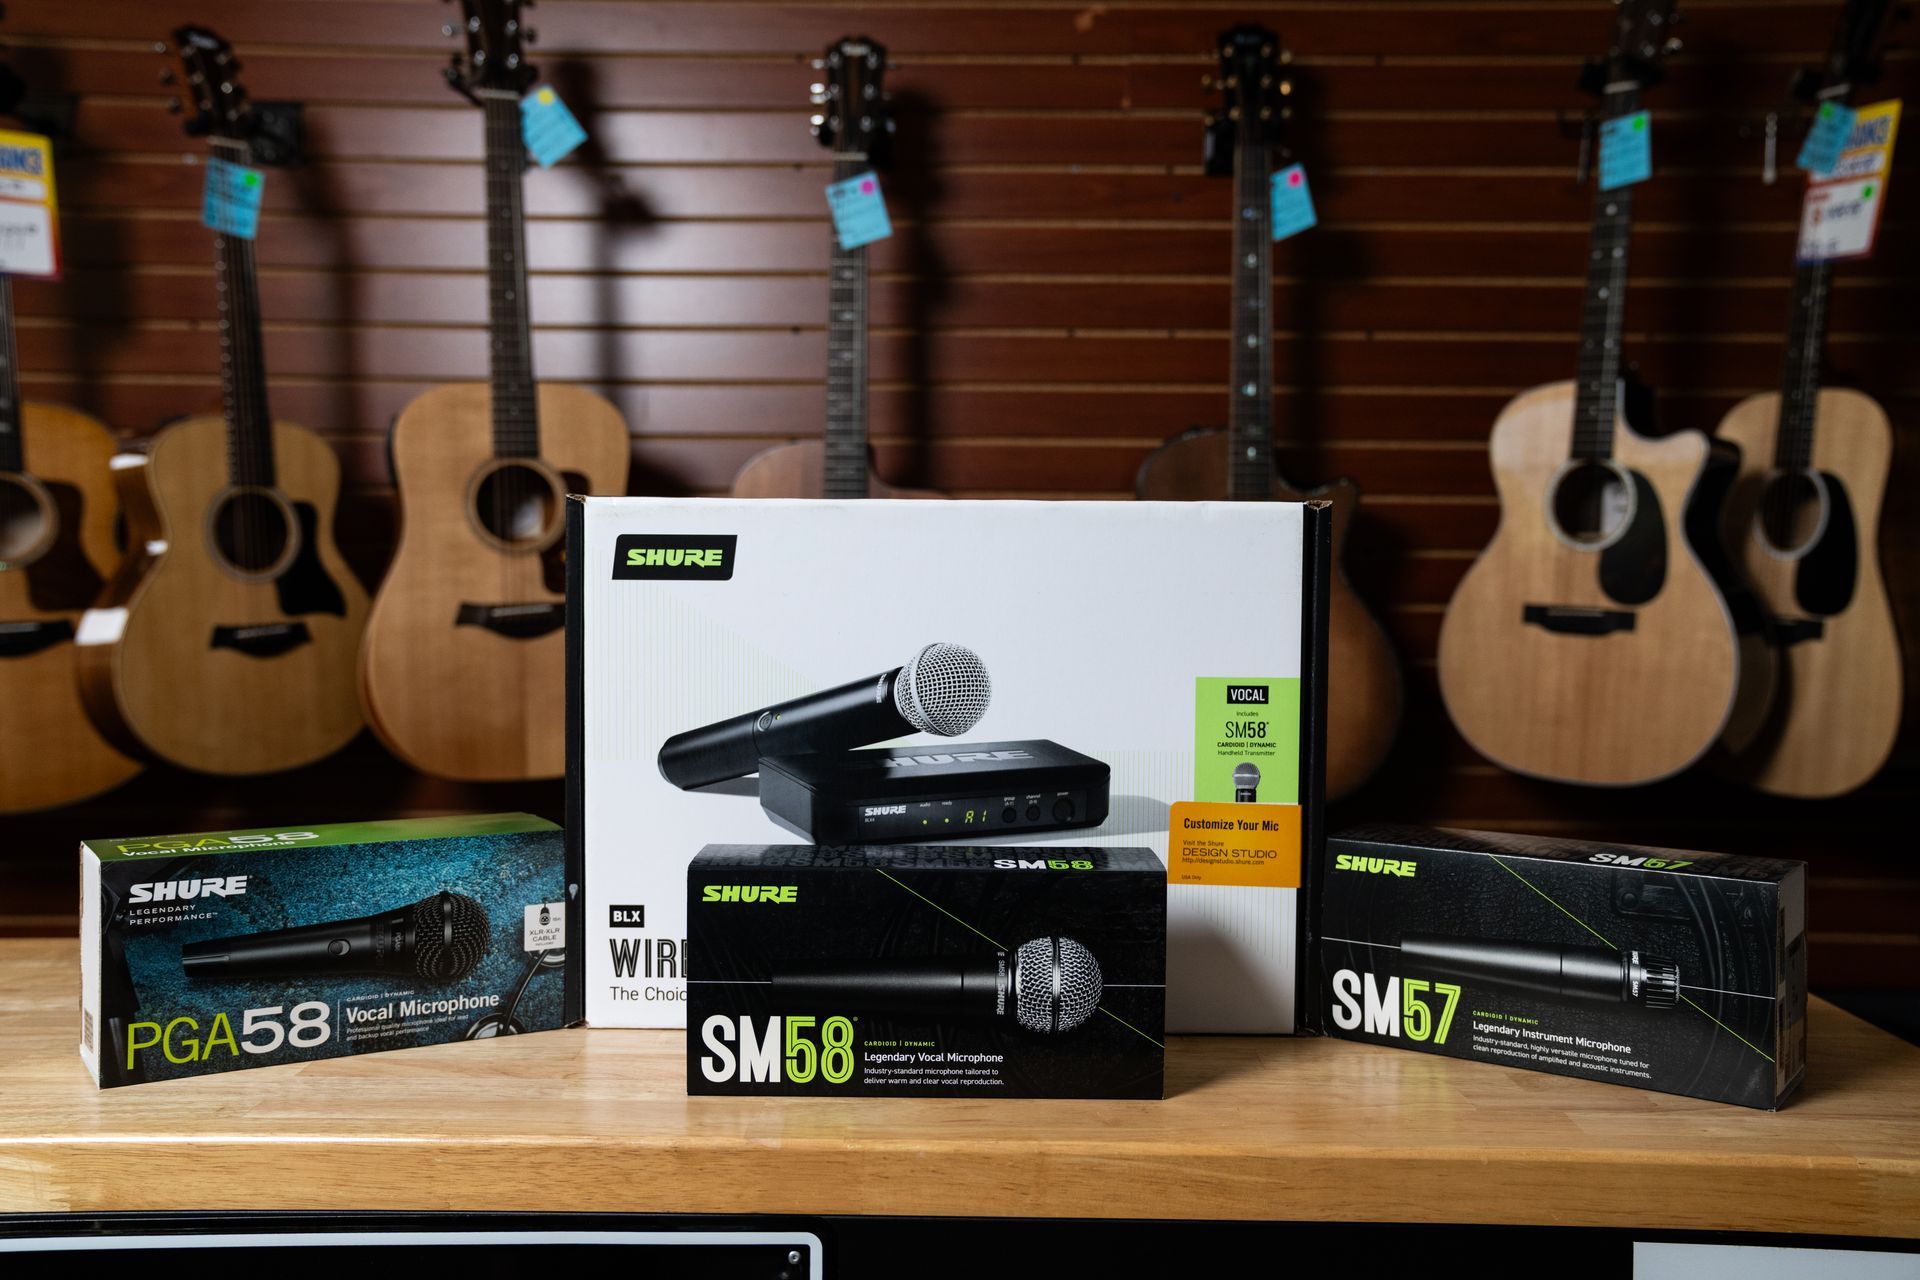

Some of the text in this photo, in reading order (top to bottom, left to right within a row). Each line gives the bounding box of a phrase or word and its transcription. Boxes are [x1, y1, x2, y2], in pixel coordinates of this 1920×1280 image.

[627, 548, 723, 568] SHURE
[1230, 688, 1265, 701] VOCAL
[864, 805, 907, 817] SHURE
[1184, 817, 1279, 832] Customize Your Mic
[115, 831, 320, 853] PGA58
[123, 840, 296, 857] Vocal Microphone
[1182, 848, 1278, 859] DESIGN STUDIO
[1588, 853, 1695, 870] SM57
[993, 859, 1094, 870] SM58
[1335, 854, 1417, 878] SHURE
[129, 875, 248, 904] SHURE
[702, 885, 798, 904] SHURE
[129, 904, 196, 916] LEGENDARY
[613, 910, 641, 922] BLX
[346, 990, 415, 1001] CARDIOID DYNAMIC
[609, 986, 639, 1001] The
[996, 983, 1005, 1015] SHURE
[346, 994, 500, 1023] Vocal Microphone
[1332, 968, 1461, 1045] SM57
[1472, 1010, 1539, 1025] CARDIOID DYNAMIC
[127, 1001, 331, 1070] PGA58
[346, 1024, 380, 1034] Professional
[381, 1022, 401, 1031] quality
[346, 1034, 358, 1042] and
[358, 1031, 379, 1041] backup
[379, 1029, 395, 1037] vocal
[1473, 1020, 1631, 1054] Legendary Instrument Microphone
[700, 1015, 855, 1084] SM58
[1473, 1034, 1650, 1069] Industry-standard, highly versatile microphone tuned for
[864, 1052, 1004, 1064] Legendary Vocal Microphone
[1473, 1043, 1652, 1079] clean reproduction of amplified and acoustic instruments.
[864, 1067, 924, 1076] Industry-standard
[925, 1068, 963, 1076] microphone
[922, 1077, 939, 1085] clear
[941, 1077, 959, 1085] vocal
[960, 1078, 1005, 1086] reproduction.
